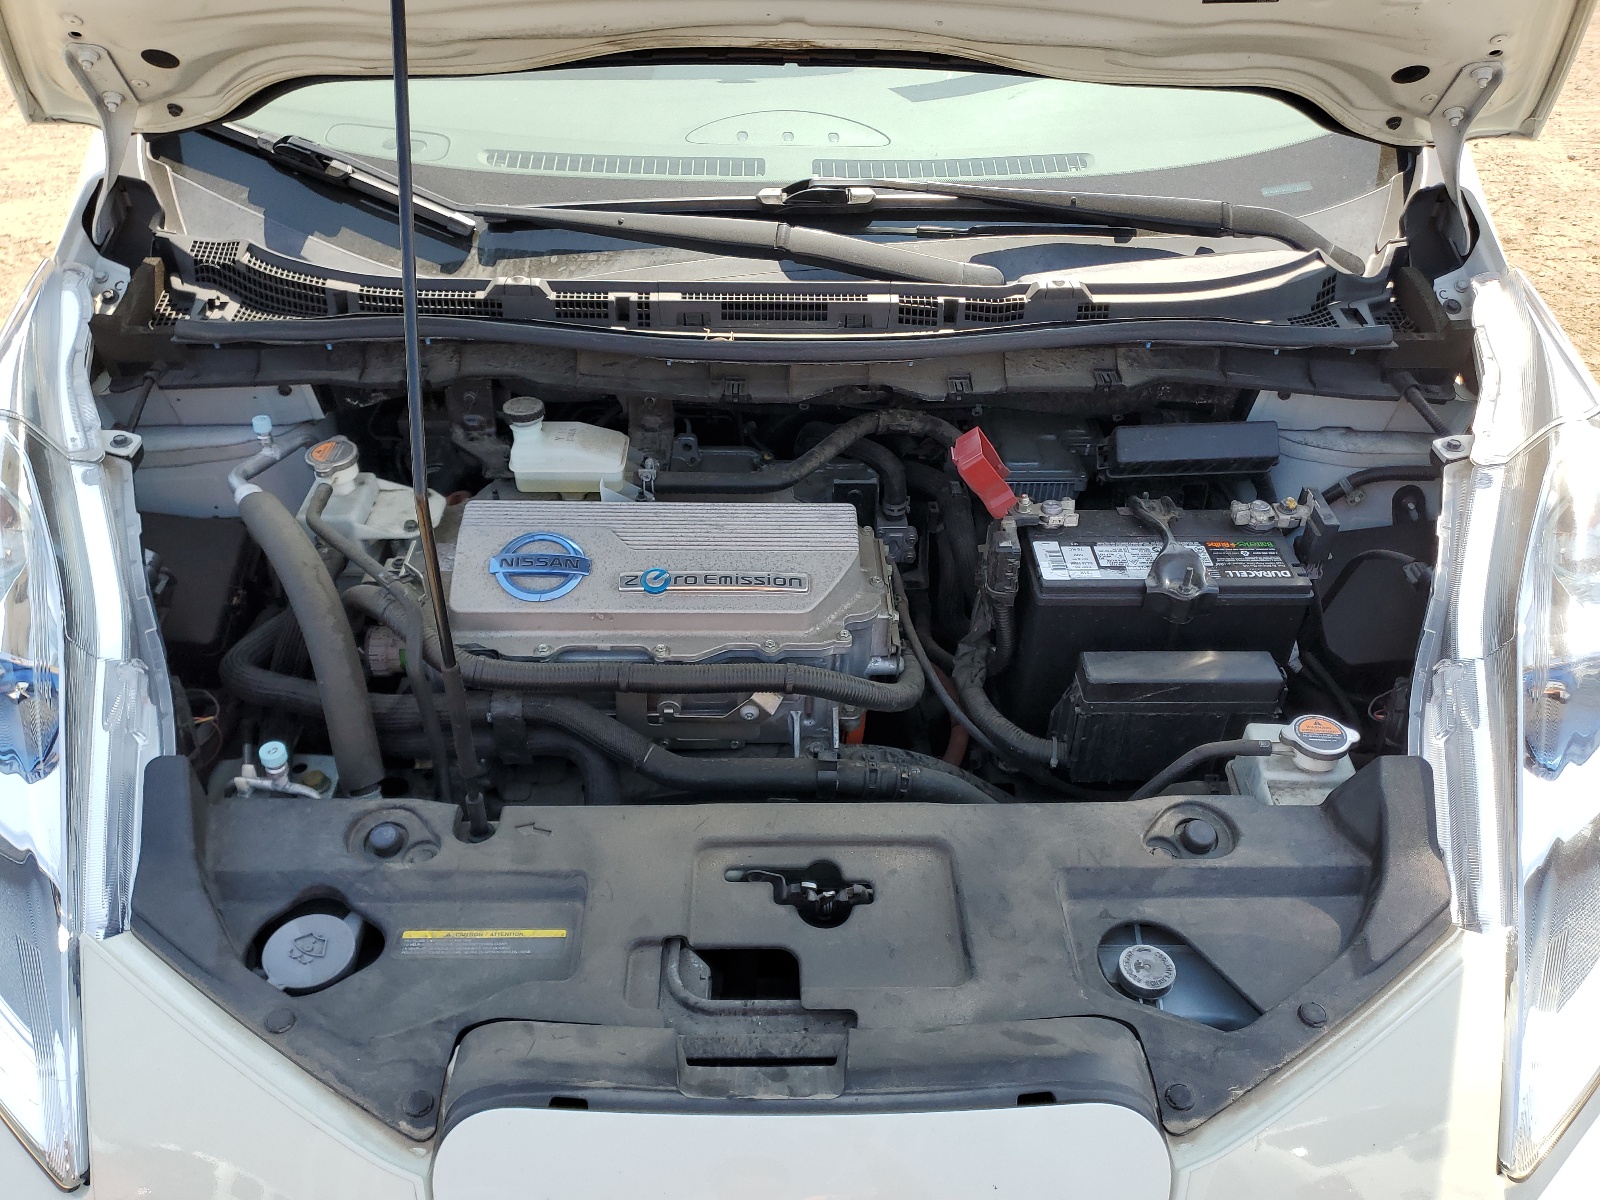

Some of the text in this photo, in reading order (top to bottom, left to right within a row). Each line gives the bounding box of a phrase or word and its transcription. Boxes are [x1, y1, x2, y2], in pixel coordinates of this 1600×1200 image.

[499, 556, 581, 571] NISSAN
[702, 573, 804, 588] Emission
[1225, 570, 1292, 578] DURACELL
